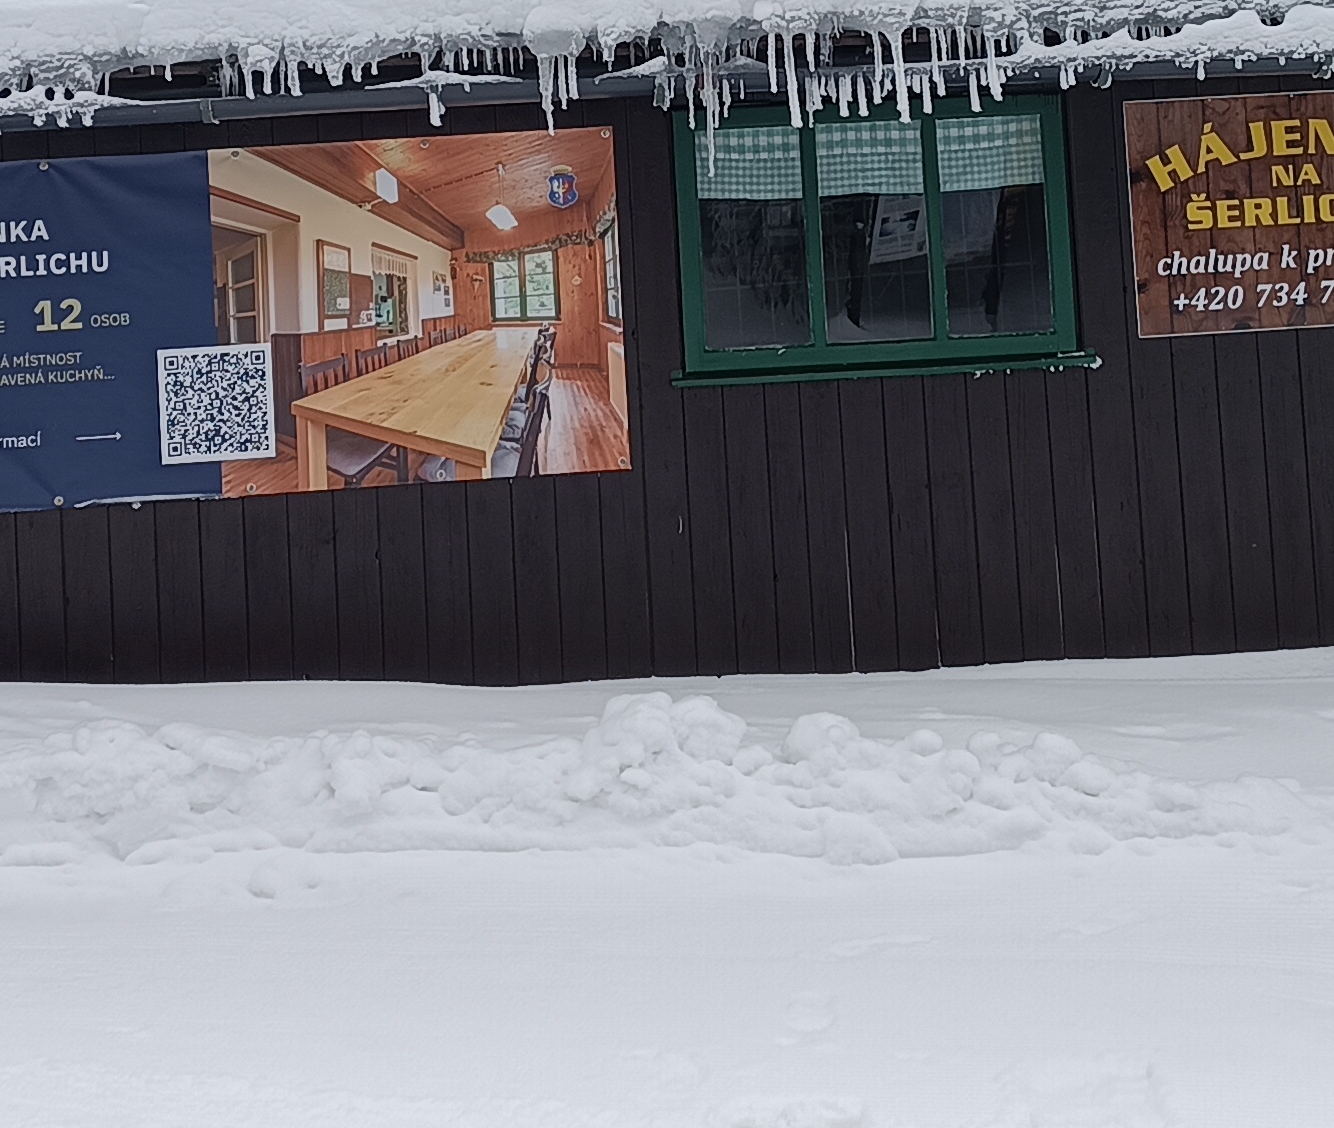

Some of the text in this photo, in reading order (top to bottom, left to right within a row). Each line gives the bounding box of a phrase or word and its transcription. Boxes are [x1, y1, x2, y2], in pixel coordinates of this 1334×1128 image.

[1271, 164, 1321, 187] NA
[1157, 249, 1269, 277] chalupa
[1280, 244, 1298, 269] k
[1173, 285, 1245, 312] +420
[1255, 281, 1308, 308] 734
[33, 298, 130, 332] 12 OSOB
[13, 351, 83, 368] MÍSTNOST
